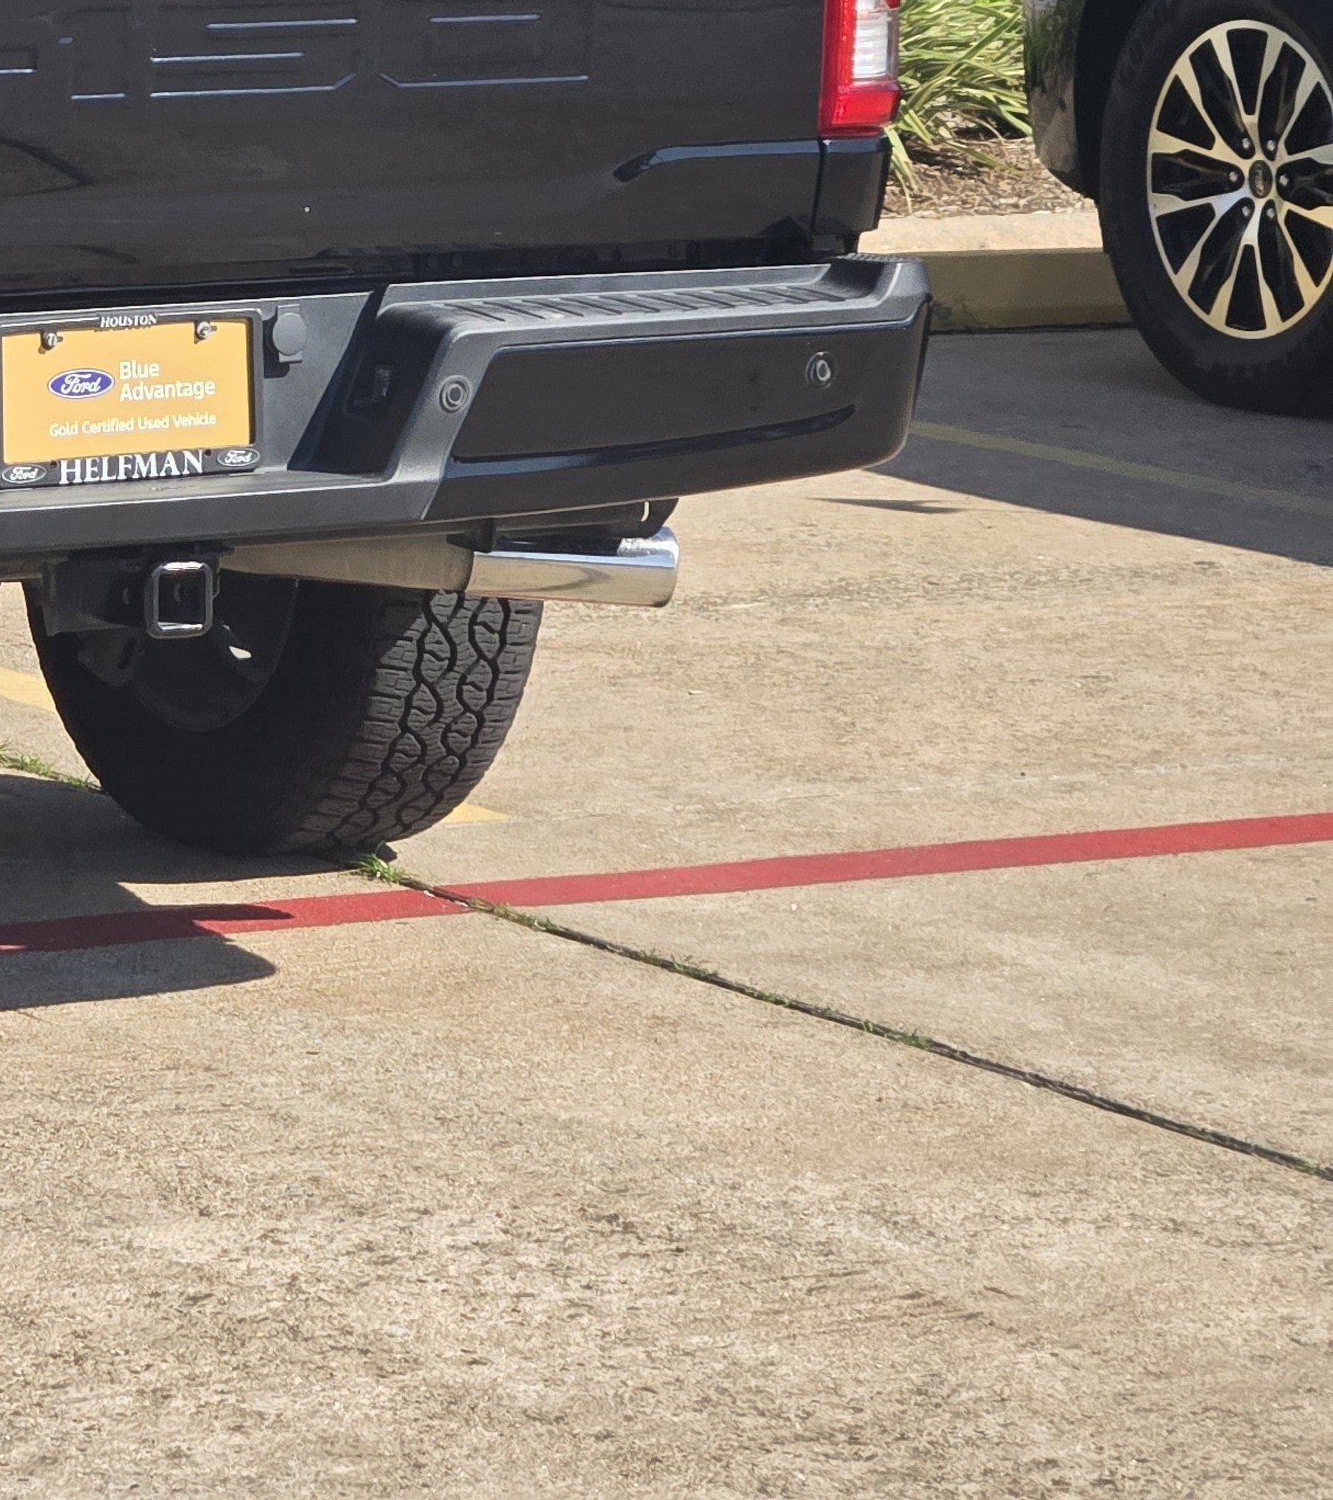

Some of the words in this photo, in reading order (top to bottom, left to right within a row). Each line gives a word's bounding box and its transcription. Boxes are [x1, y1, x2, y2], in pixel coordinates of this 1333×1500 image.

[99, 313, 158, 328] HOUSTON
[119, 360, 160, 380] Blue
[60, 373, 103, 394] Ford
[119, 380, 216, 402] Advantage
[48, 421, 79, 437] Gold
[81, 417, 134, 435] Certified
[138, 414, 170, 431] Used
[172, 412, 217, 428] Vehicle
[9, 466, 39, 481] Ford
[58, 449, 204, 485] HELFMAN
[224, 449, 253, 464] Ford
